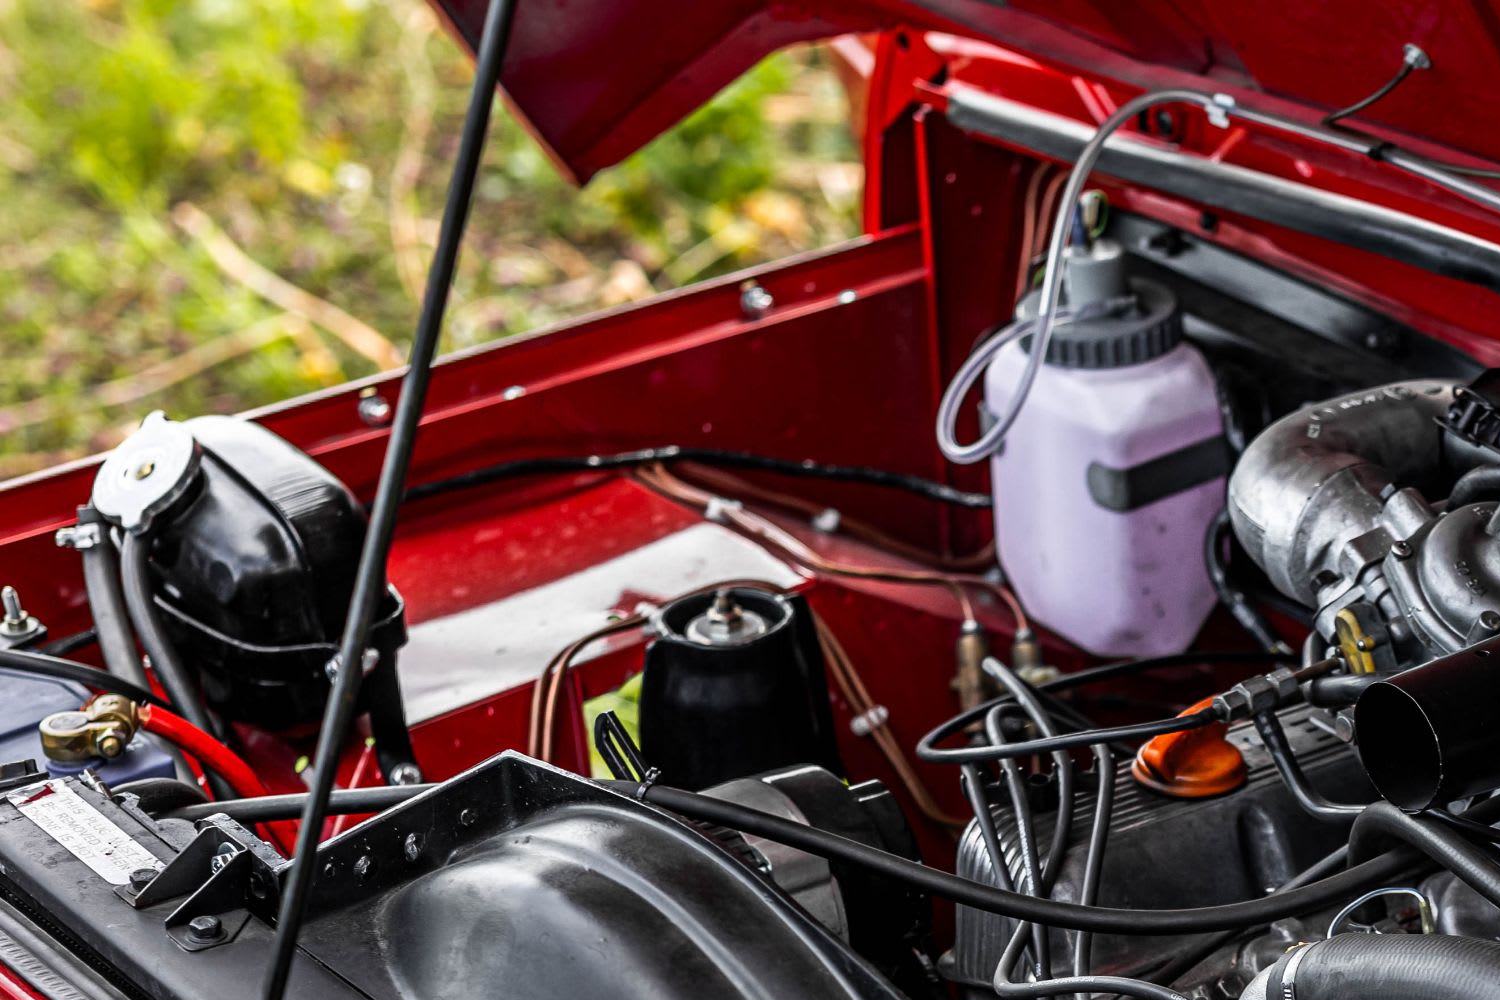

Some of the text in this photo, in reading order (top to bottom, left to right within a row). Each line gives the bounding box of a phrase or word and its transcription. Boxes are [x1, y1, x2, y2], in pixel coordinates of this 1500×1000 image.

[60, 797, 85, 815] THIS
[56, 812, 102, 845] REMOVED
[58, 832, 74, 842] IS
[70, 843, 96, 860] HOT
